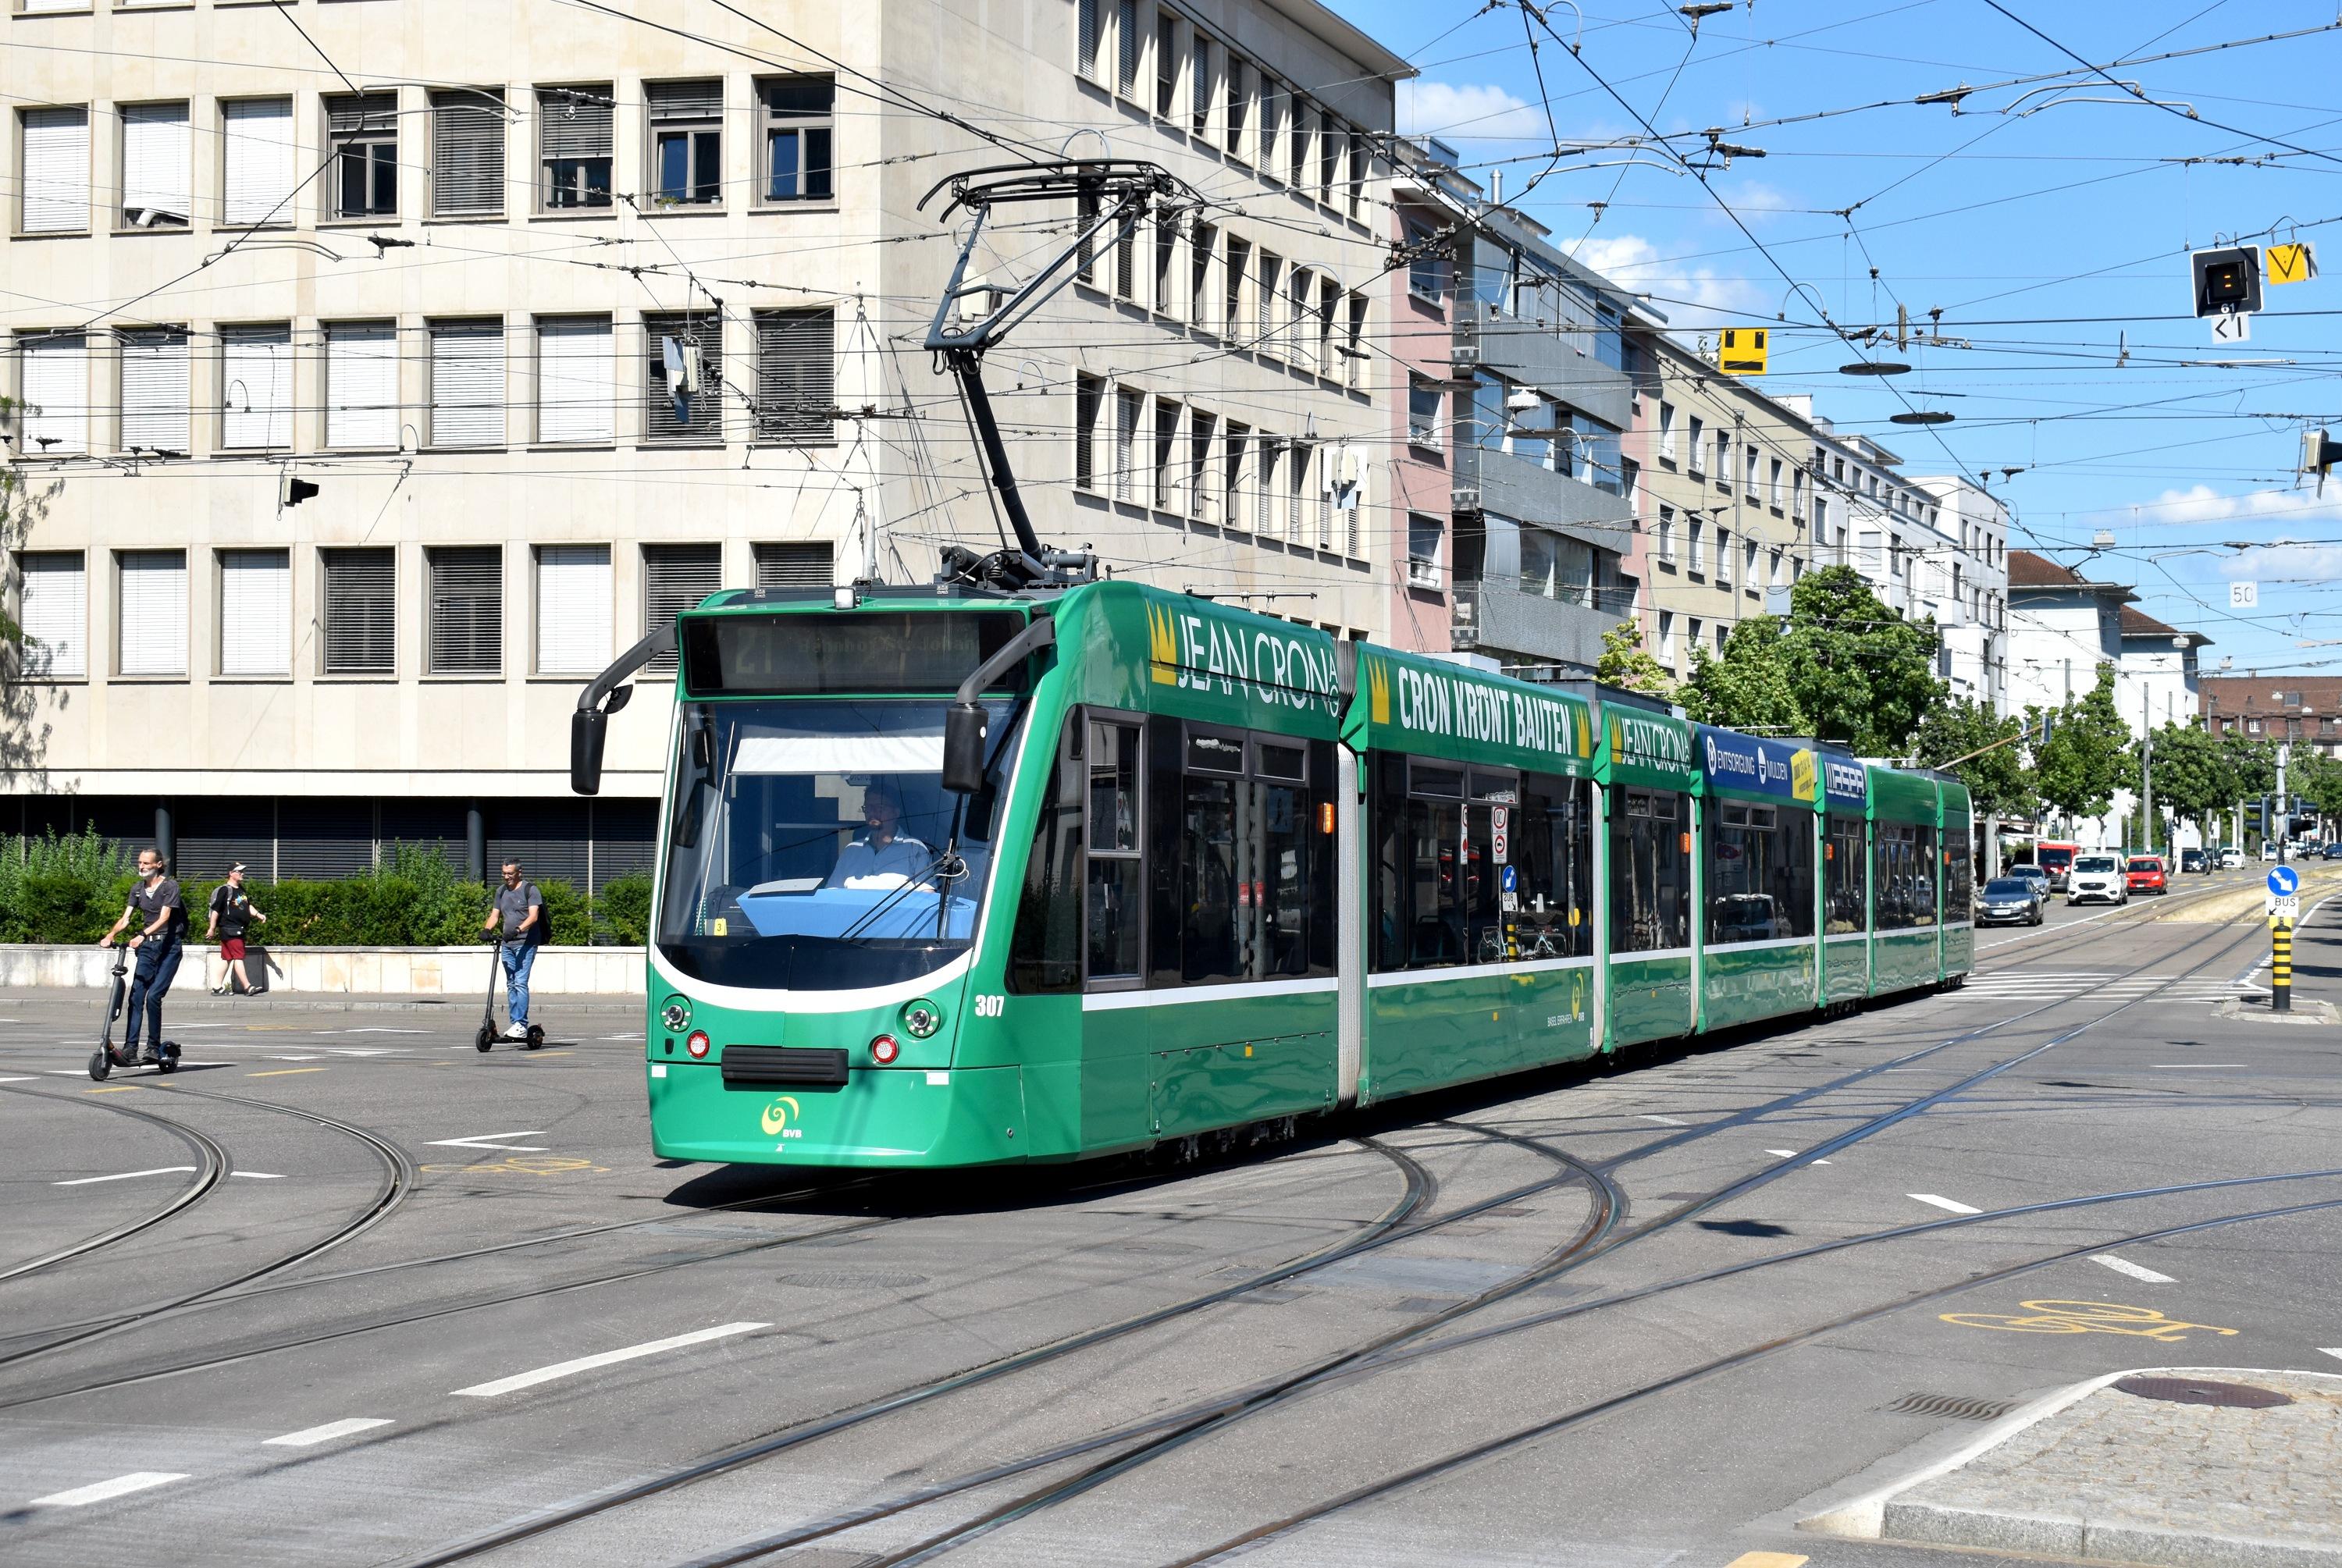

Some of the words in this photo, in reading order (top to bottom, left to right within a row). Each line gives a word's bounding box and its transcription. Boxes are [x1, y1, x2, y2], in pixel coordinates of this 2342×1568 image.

[2220, 303, 2235, 314] 61
[2233, 586, 2253, 603] 50
[1177, 614, 1249, 701] JEAN
[1254, 632, 1329, 715] CRON
[1398, 667, 1450, 735] CRON
[1453, 679, 1509, 745] KRÖNT
[1513, 693, 1571, 755] BAUTEN
[1621, 718, 1651, 770] JEAN
[1653, 724, 1685, 775] CRON
[1717, 750, 1755, 775] ENTSORGUNG
[1767, 760, 1788, 780] MULDEN
[2275, 898, 2296, 907] BUS
[717, 923, 722, 932] 3
[975, 994, 1005, 1017] 307
[782, 1129, 803, 1138] BVB
